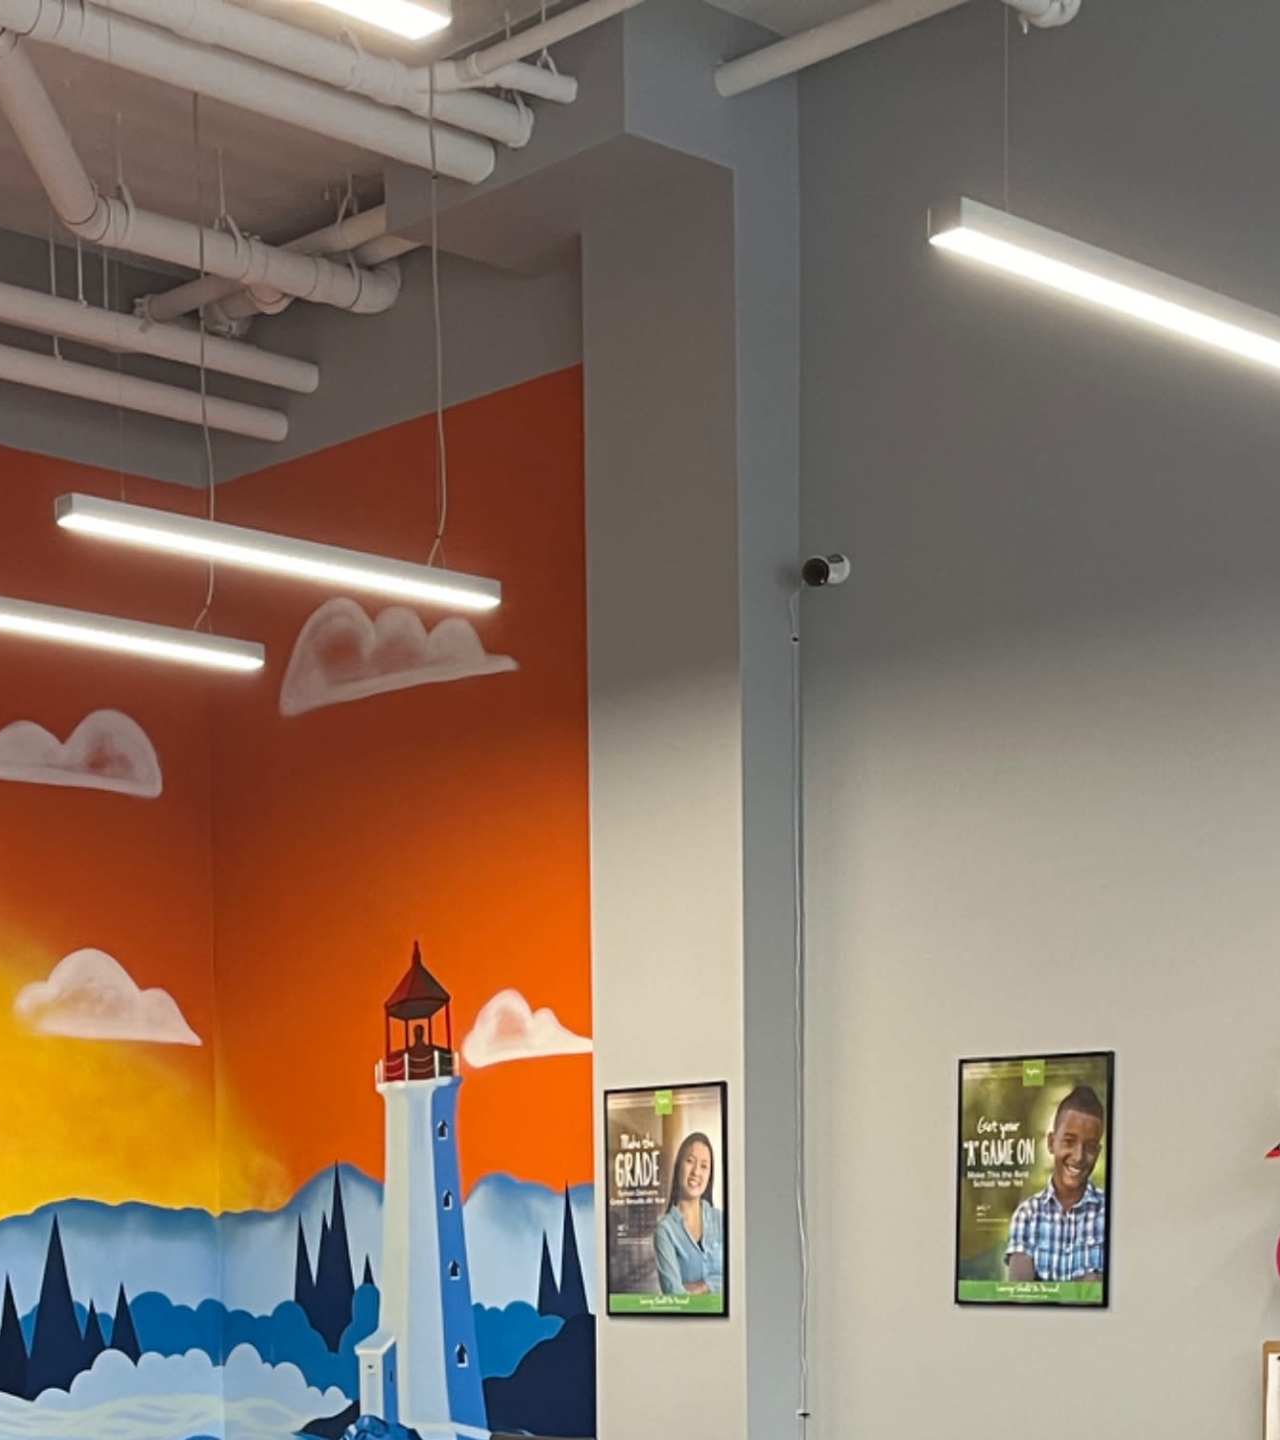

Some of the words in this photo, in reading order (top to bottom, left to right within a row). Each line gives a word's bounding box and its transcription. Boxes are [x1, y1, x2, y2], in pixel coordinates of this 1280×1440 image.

[980, 1138, 1015, 1166] GAME
[1016, 1136, 1036, 1165] ON
[614, 1150, 661, 1188] GRADE
